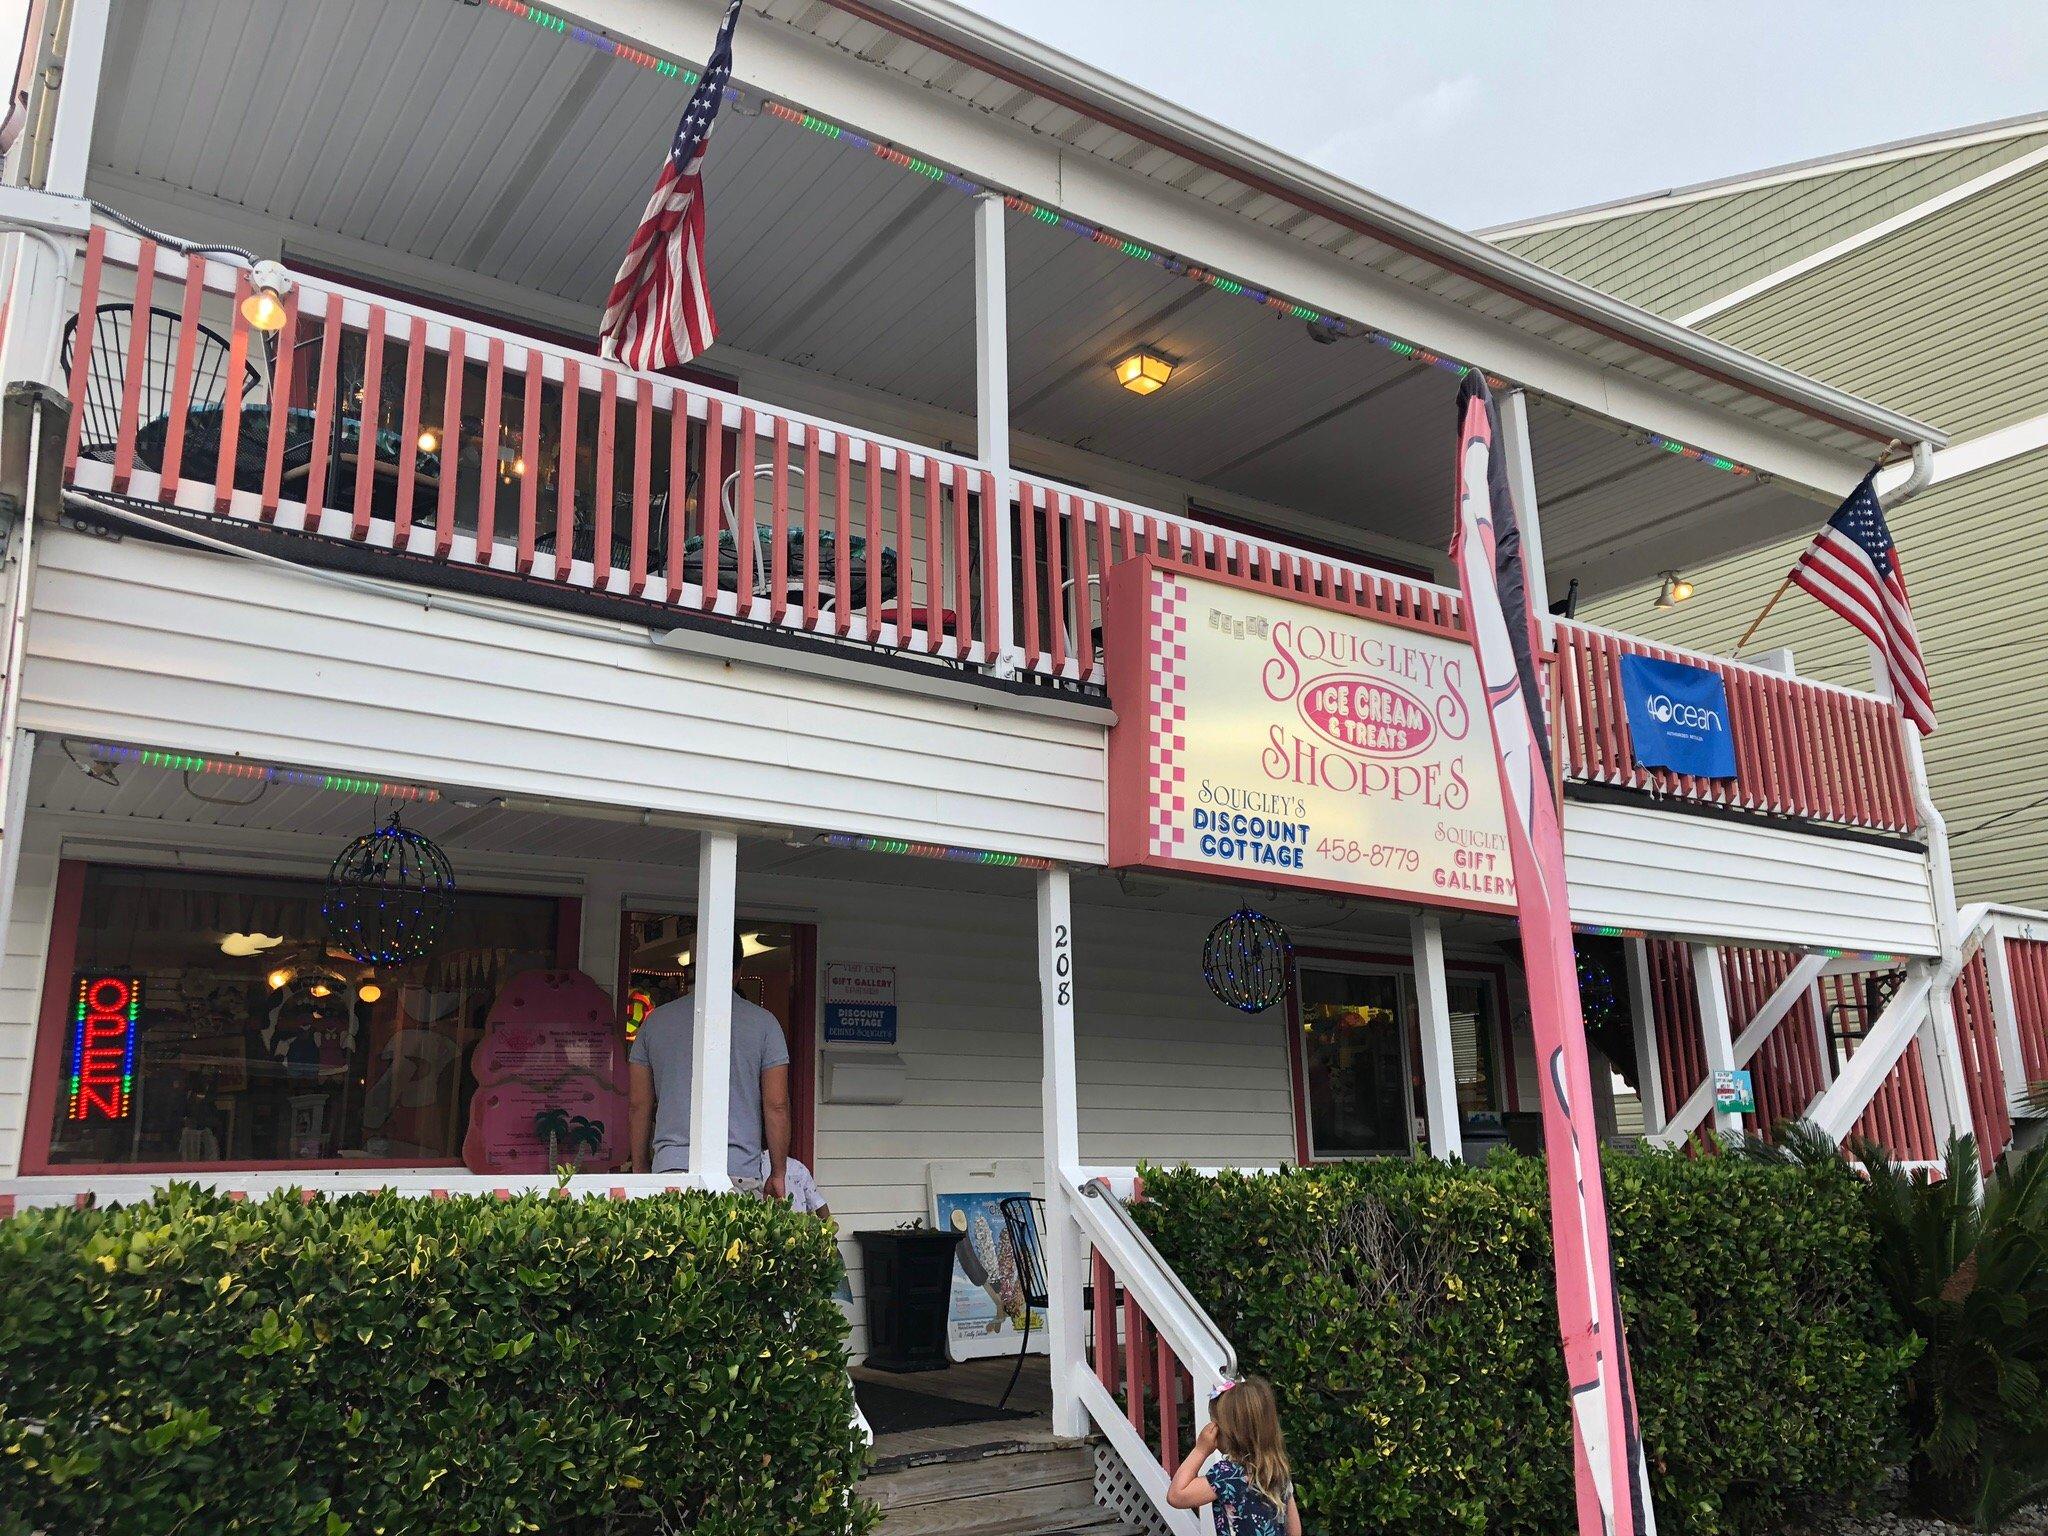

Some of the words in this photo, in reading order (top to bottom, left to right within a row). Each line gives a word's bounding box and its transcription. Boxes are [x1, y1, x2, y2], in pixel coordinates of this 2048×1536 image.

[1263, 621, 1469, 740] SQUIGLEY'S
[1315, 685, 1350, 716] ICE
[1354, 685, 1424, 731] CREAM
[1328, 717, 1341, 738] &
[1344, 719, 1408, 749] TREATS
[1262, 724, 1469, 810] SHOPPES
[1198, 779, 1306, 818] SQUIGLEY'S
[1193, 807, 1310, 845] DISCOUNT
[1200, 834, 1304, 869] COTTAGE
[1316, 837, 1420, 872] 458-8779
[1454, 848, 1496, 872] GIFT
[1433, 867, 1515, 897] GALLERY
[832, 977, 852, 986] GIFT
[854, 978, 892, 988] GALLERY
[1055, 925, 1070, 1006] 208
[838, 1008, 885, 1019] DISCOUNT
[841, 1017, 882, 1028] COTTAGE
[78, 977, 130, 1120] OPEN
